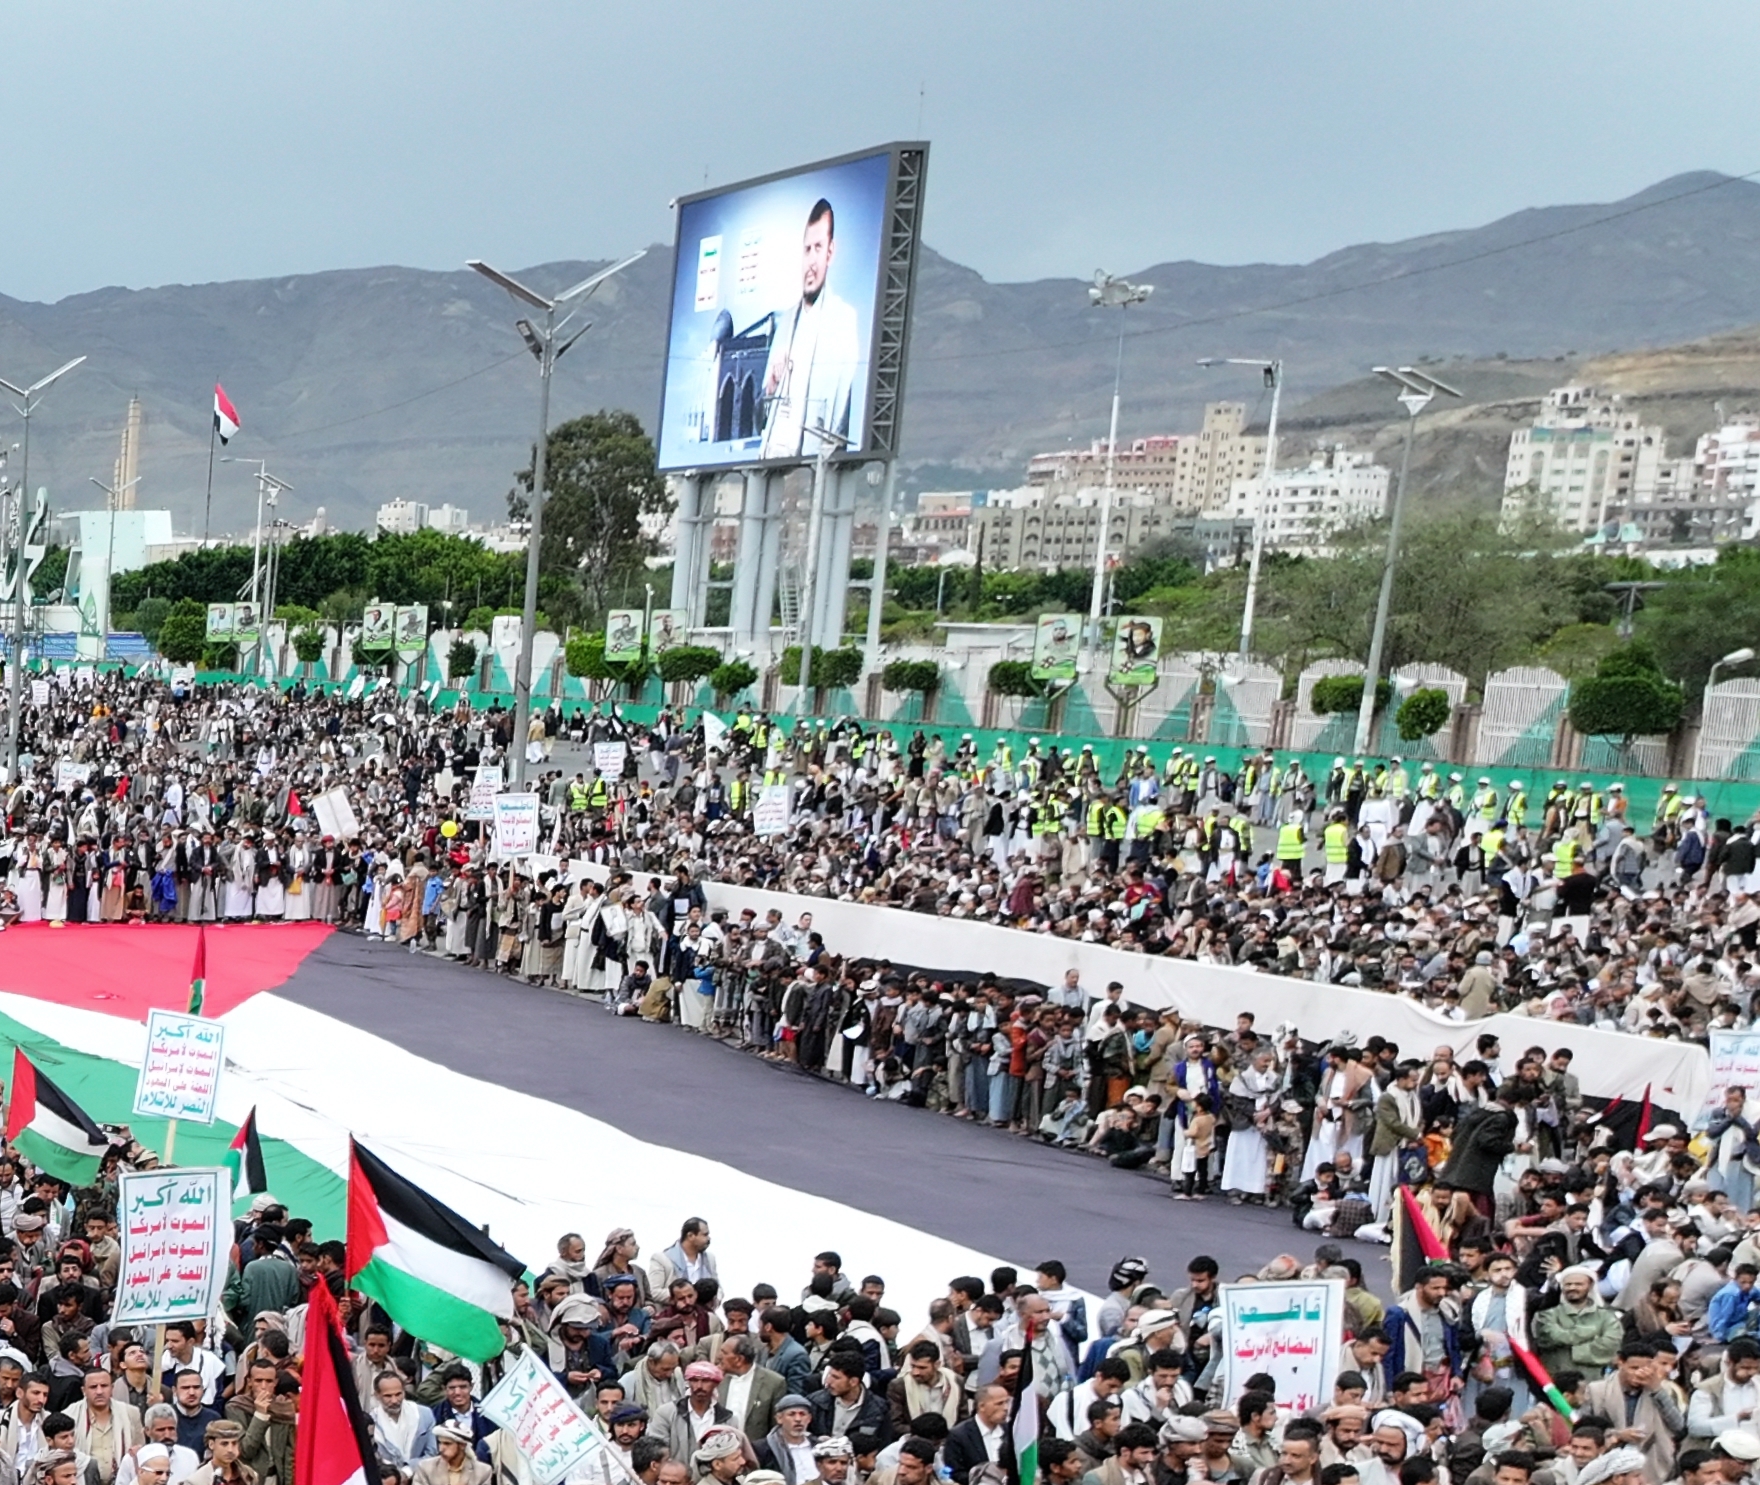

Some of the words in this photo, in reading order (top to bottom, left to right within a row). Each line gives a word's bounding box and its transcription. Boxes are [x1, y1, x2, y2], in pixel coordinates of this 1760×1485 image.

[130, 1178, 178, 1215] أكبر
[178, 1181, 212, 1205] الله
[170, 1215, 210, 1231] الموت
[169, 1242, 209, 1257] الموت
[126, 1268, 154, 1288] اليهود
[156, 1265, 172, 1284] على
[176, 1265, 208, 1281] اللعنة
[120, 1289, 161, 1315] للإسلام
[163, 1285, 205, 1313] النصر
